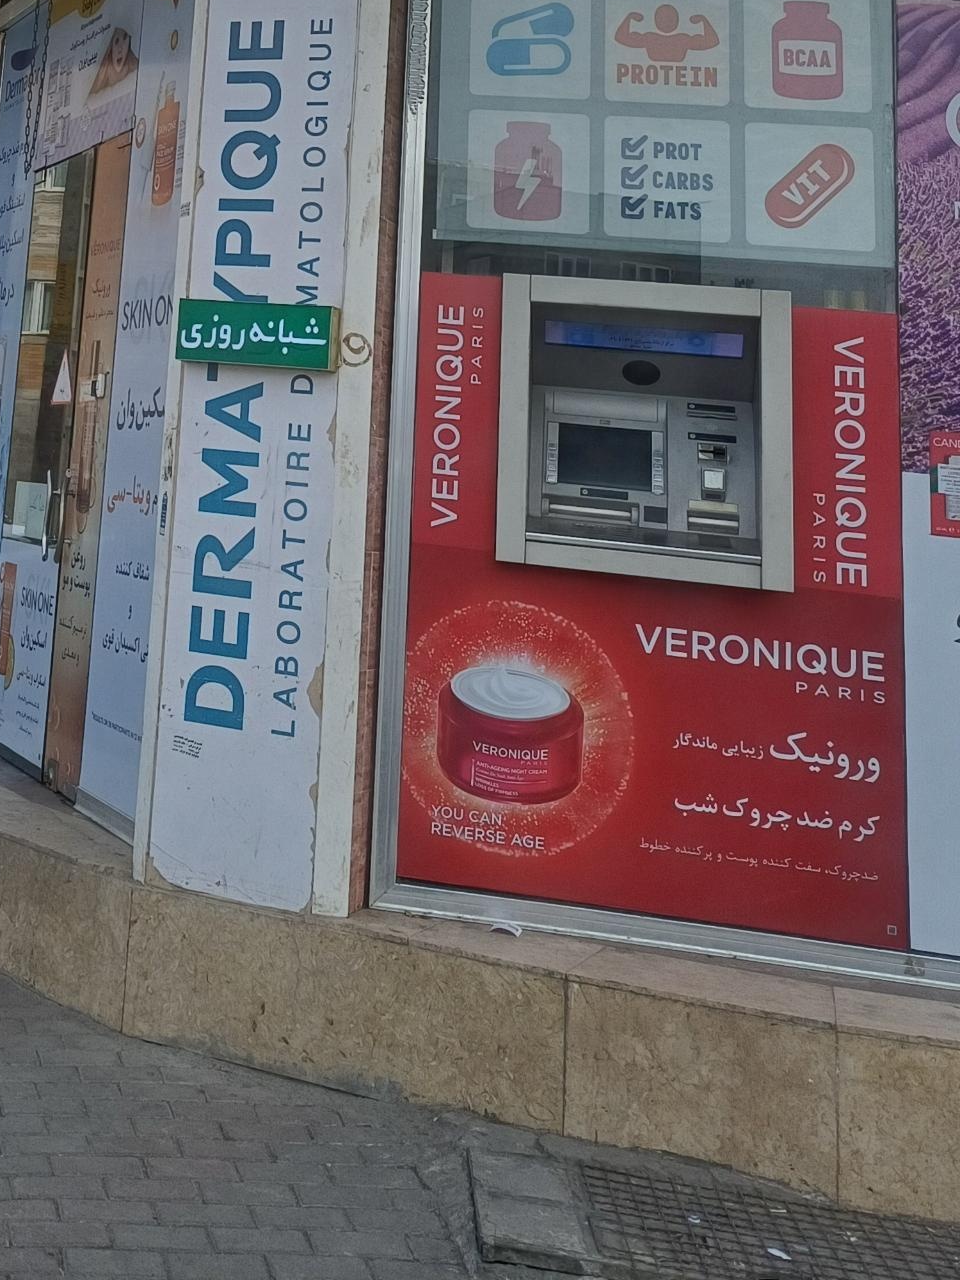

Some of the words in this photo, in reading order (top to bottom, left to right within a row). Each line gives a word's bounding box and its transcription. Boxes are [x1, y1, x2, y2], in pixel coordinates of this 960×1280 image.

[782, 47, 832, 69] BCAA
[616, 63, 718, 88] PROTEIN
[652, 142, 702, 161] PROT
[652, 171, 714, 192] CARBS
[781, 158, 833, 207] VIT
[652, 201, 702, 220] FATS
[121, 299, 152, 331] SKIN
[181, 314, 245, 350] روزی
[249, 317, 327, 355] شبانه
[469, 306, 485, 385] PARIS
[183, 20, 286, 731] DERMAYPIQUE
[430, 304, 465, 528] VERONIQUE
[933, 436, 960, 449] CAN
[833, 336, 869, 589] VERONIQUE
[812, 492, 827, 584] PARIS
[270, 422, 313, 738] LABORATOIRE
[634, 623, 886, 682] VERONIQUE
[795, 681, 886, 704] PARIS
[472, 740, 549, 760] VERONIQUE
[672, 732, 718, 751] ماندگار
[722, 741, 764, 760] زیبایی
[769, 732, 881, 783] ورونیک
[431, 804, 464, 820] YOU
[469, 810, 503, 826] CAN
[673, 793, 718, 817] شب
[722, 797, 793, 831] چروک
[796, 809, 833, 829] ضد
[838, 815, 881, 841] کرم
[431, 822, 506, 845] REVERSE
[510, 833, 545, 850] AGE
[639, 837, 671, 852] خطوط
[716, 851, 723, 863] و
[726, 850, 758, 867] پوست
[762, 857, 793, 869] کننده
[795, 861, 822, 874] سفت
